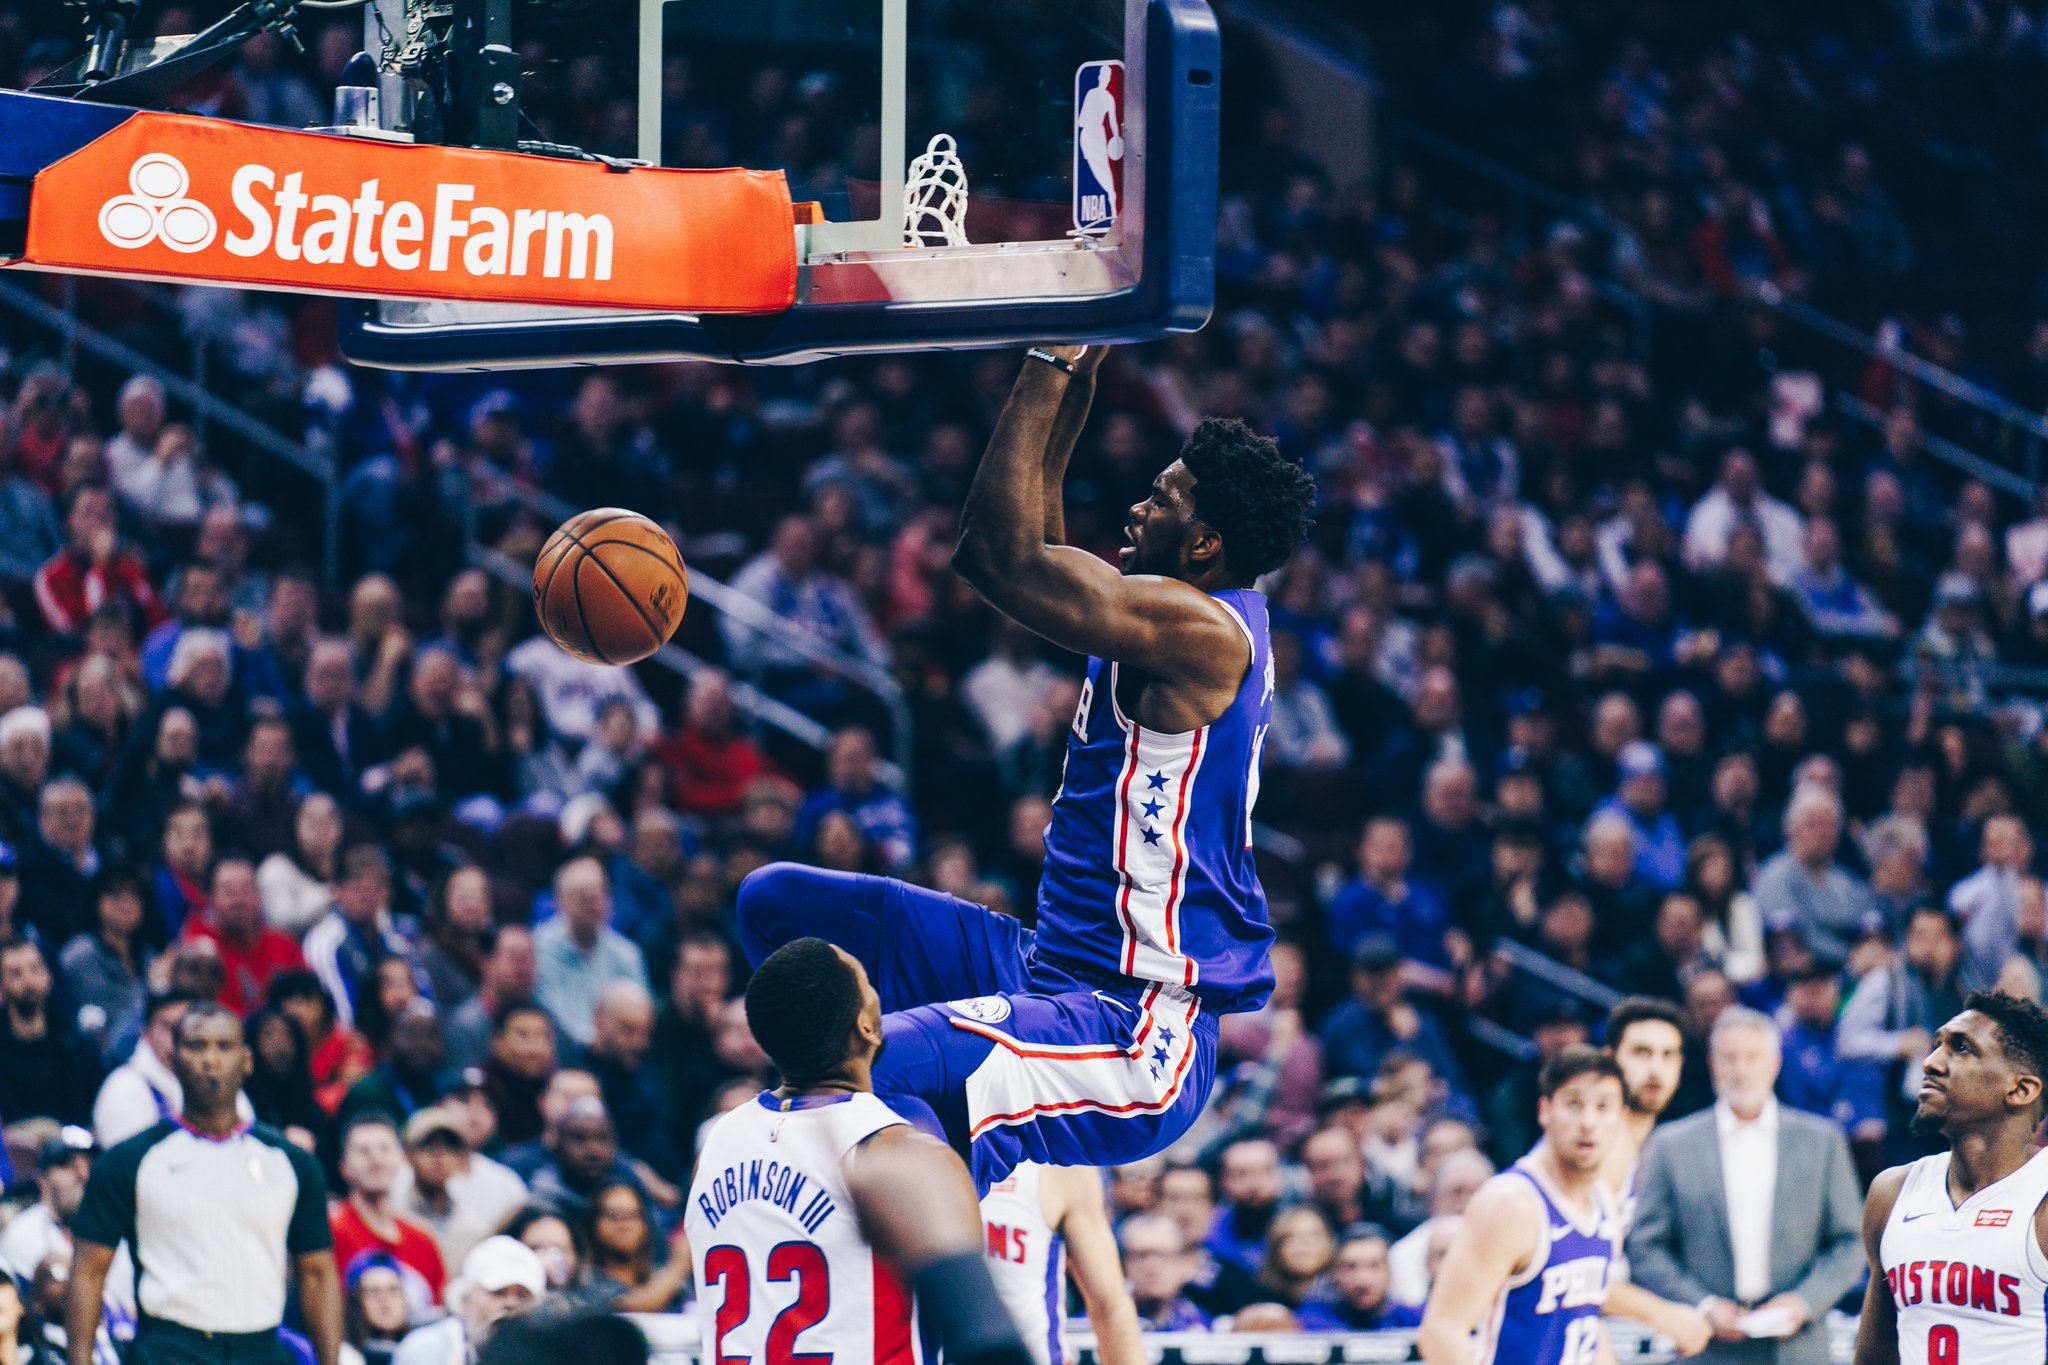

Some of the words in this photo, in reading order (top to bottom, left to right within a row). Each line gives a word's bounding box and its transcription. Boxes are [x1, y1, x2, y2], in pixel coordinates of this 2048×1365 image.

[1081, 195, 1106, 222] NBA
[698, 1159, 807, 1229] ROBINSON
[799, 1188, 836, 1235] III
[704, 1240, 834, 1365] 22
[1886, 1260, 2021, 1317] PISTONS
